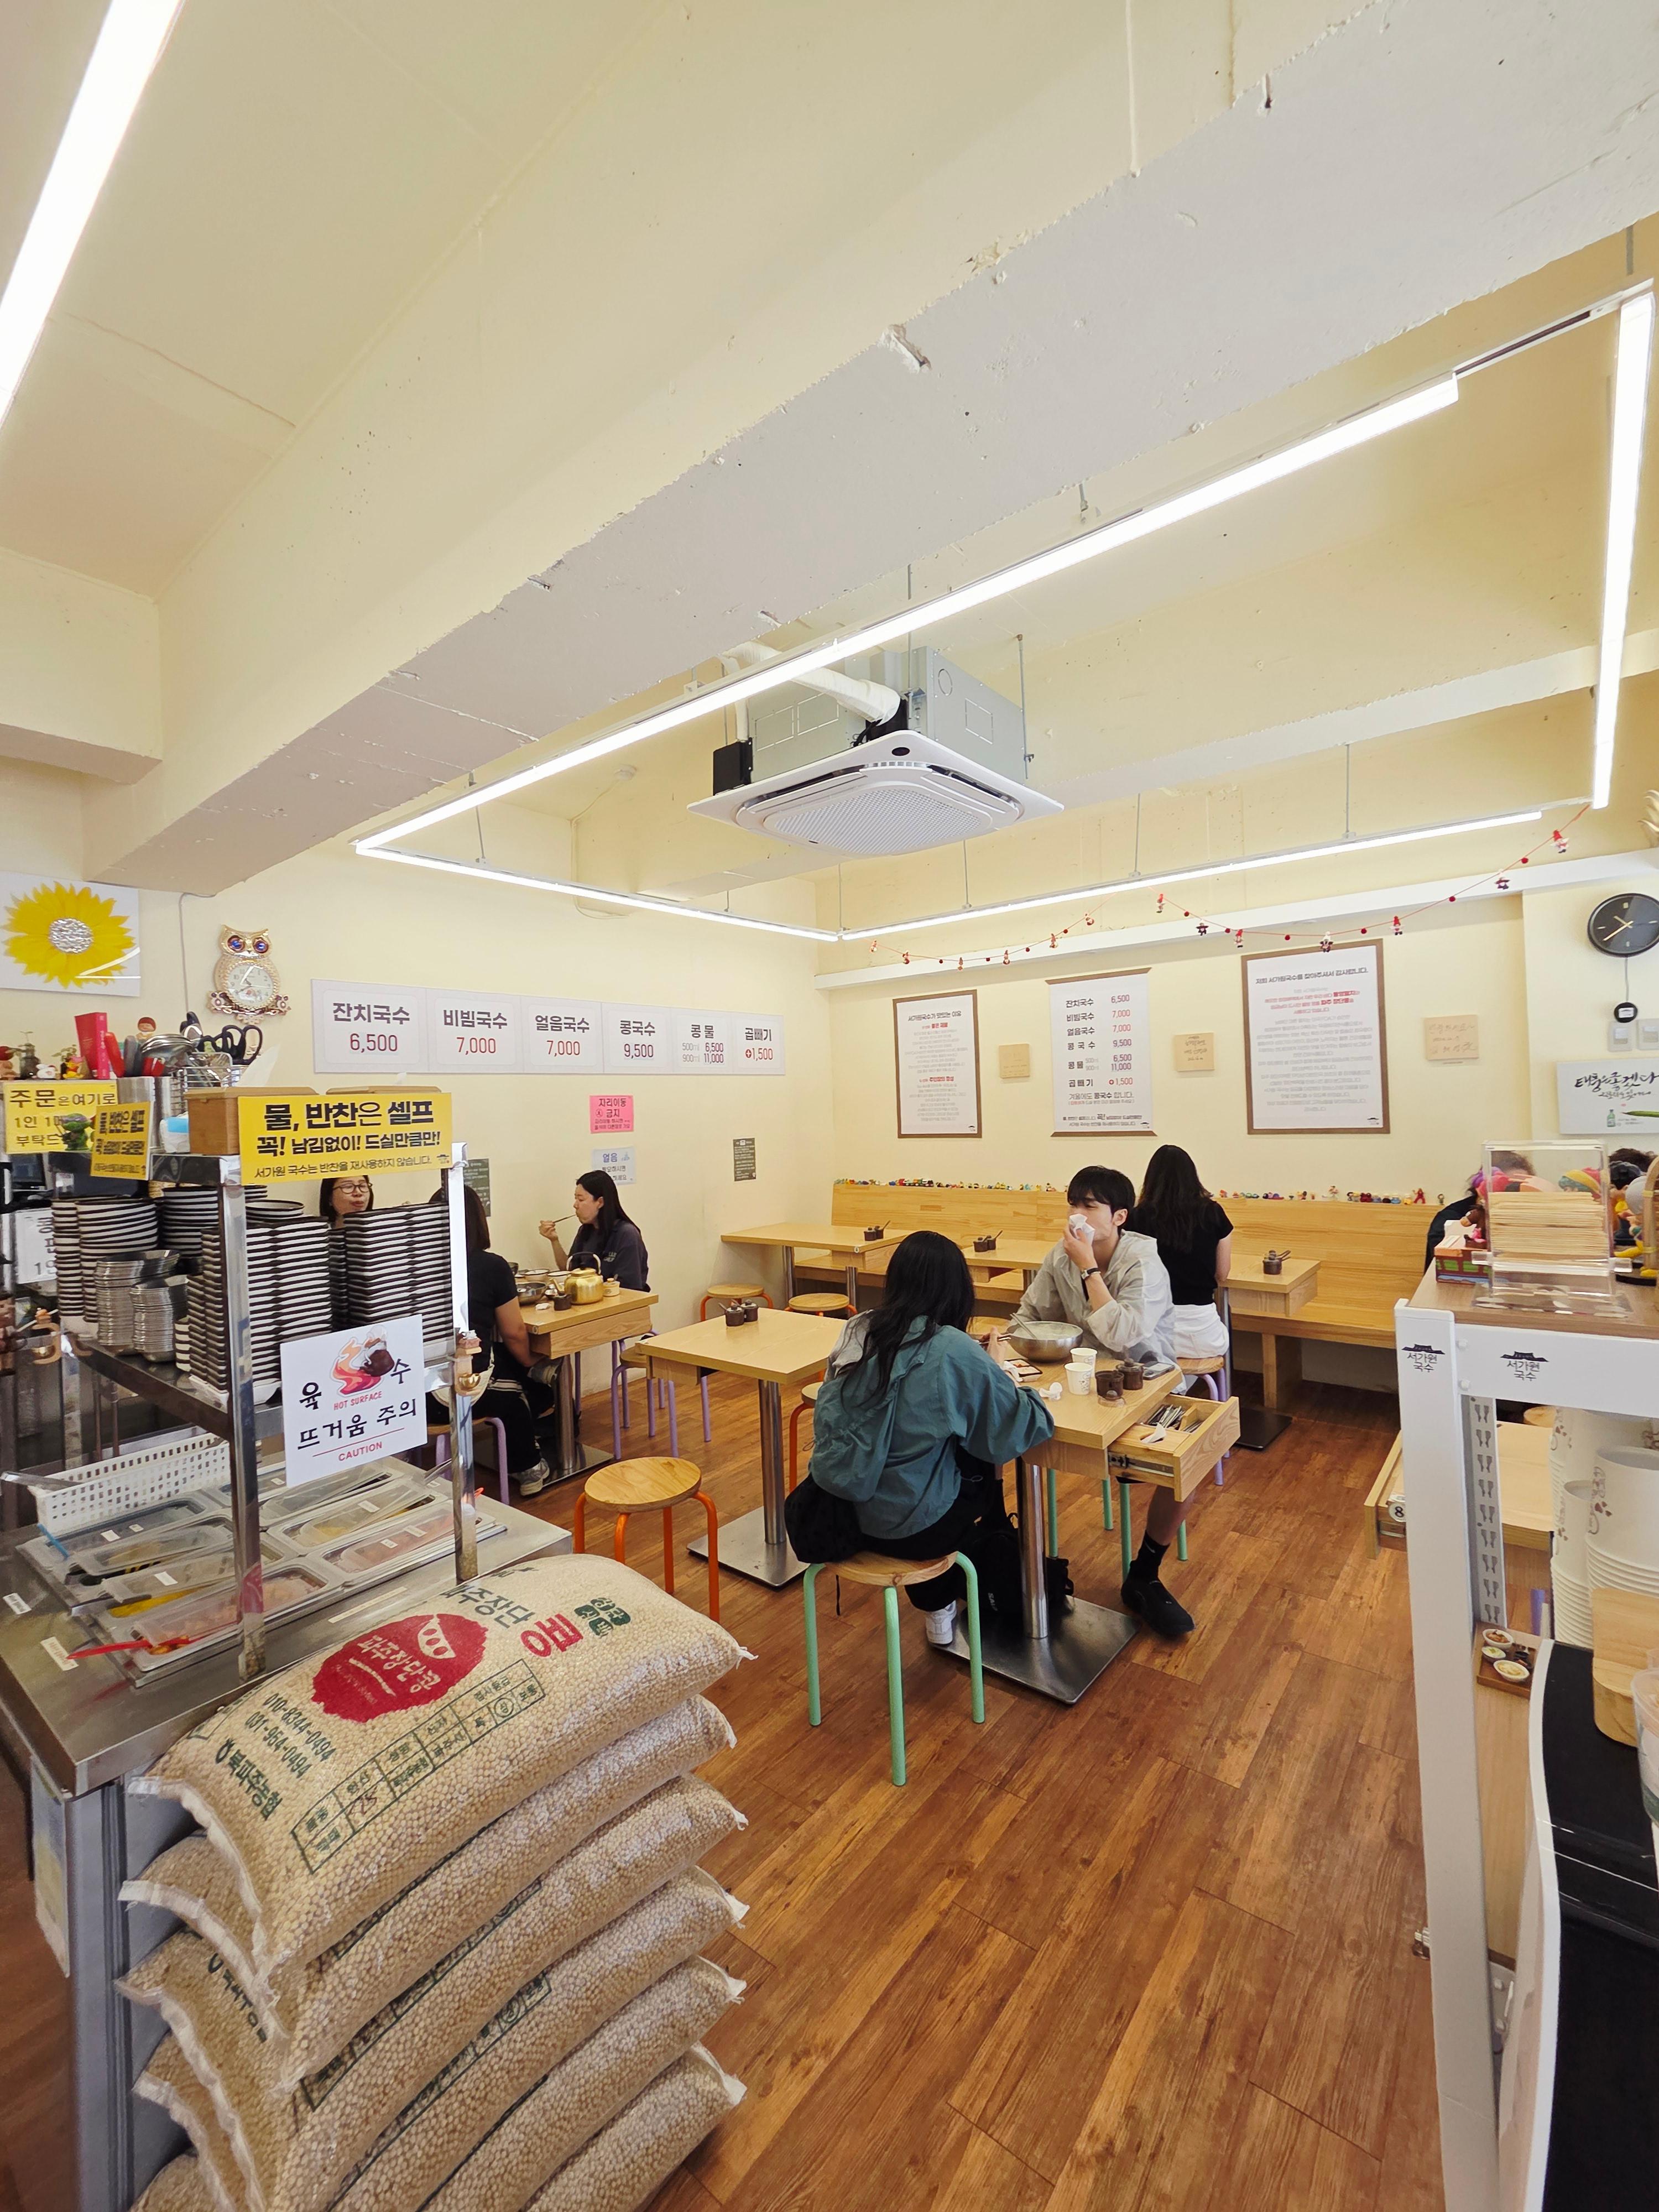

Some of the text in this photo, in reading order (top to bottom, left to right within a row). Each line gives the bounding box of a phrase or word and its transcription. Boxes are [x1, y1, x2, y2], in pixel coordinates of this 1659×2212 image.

[1066, 998, 1094, 1008] 잔치국수
[1111, 994, 1130, 1004] 6,500
[332, 1003, 410, 1025] 잔치국수
[443, 1010, 508, 1030] 비빔국수
[1066, 1012, 1094, 1022] 비빔국수
[1112, 1009, 1130, 1019] 7,000
[535, 1015, 590, 1034] 얼음국수
[620, 1020, 656, 1036] 콩국수
[1113, 1024, 1131, 1033] 7,000
[1067, 1027, 1095, 1036] 얼음국수
[349, 1033, 398, 1053] 6,500
[456, 1037, 496, 1055] 7,000
[546, 1040, 581, 1057] 7,000
[705, 1042, 724, 1053] 6,500
[1113, 1039, 1132, 1048] 9,500
[624, 1044, 654, 1059] 9,500
[1113, 1053, 1132, 1062] 6,500
[704, 1053, 724, 1064] 11,000
[1111, 1062, 1131, 1072] 11,000
[598, 1098, 627, 1107] 자리이동
[264, 1101, 434, 1131] 물, 반찬은 셀프
[606, 1109, 620, 1118] 금지
[14, 1116, 37, 1128] 1인
[257, 1131, 441, 1157] 꼭! 남김없이! 드실만큼만!
[603, 1152, 618, 1163] 얼음
[254, 1156, 432, 1178] 서가원 국수는 반찬을 재사용하지 않습니다.
[1407, 1353, 1438, 1364] 서가원
[1413, 1361, 1434, 1373] 국수
[1507, 1360, 1540, 1372] 서가원
[1514, 1370, 1536, 1381] 국수
[334, 1391, 383, 1410] HOT SURFACE
[298, 1399, 416, 1450] 뜨거움 주의
[338, 1441, 383, 1462] CAUTION
[1394, 1506, 1405, 1518] 8
[520, 1614, 584, 1657] 콩
[357, 1635, 441, 1693] 파주장단콩
[263, 1692, 337, 1762] 010-8344-0494
[245, 1711, 313, 1779] 031-954-0494
[228, 1749, 283, 1821] 북파주농협
